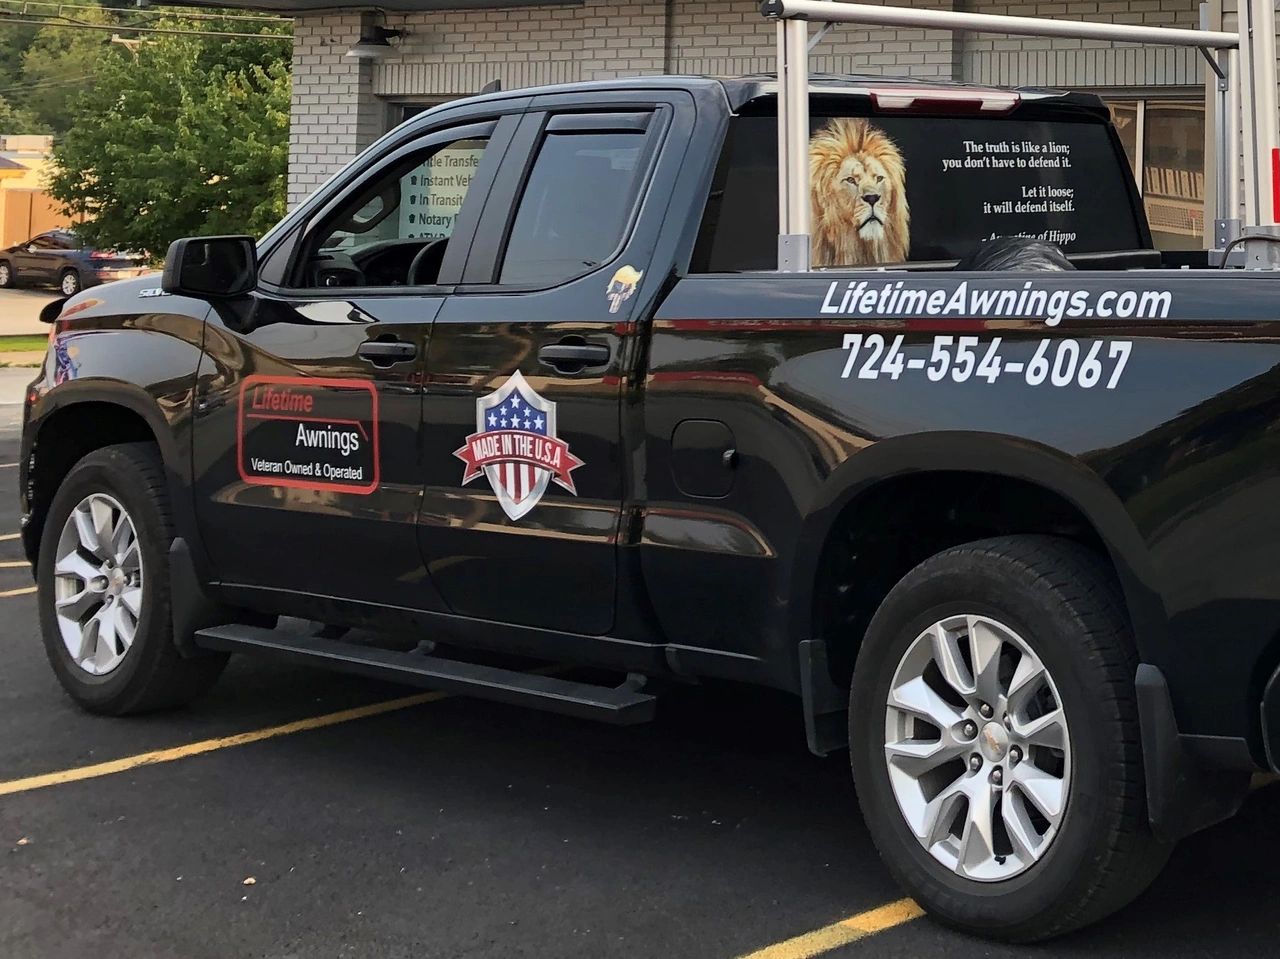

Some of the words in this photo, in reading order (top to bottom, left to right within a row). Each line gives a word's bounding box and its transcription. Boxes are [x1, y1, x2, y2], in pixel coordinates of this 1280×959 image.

[963, 141, 984, 153] The
[985, 141, 1010, 153] truth
[1011, 141, 1020, 153] is
[1022, 141, 1040, 153] like
[1041, 144, 1048, 153] a
[1049, 141, 1070, 155] lion;
[444, 155, 479, 167] Transfe
[942, 159, 962, 172] you
[964, 156, 990, 168] don't
[992, 156, 1015, 168] have
[1016, 157, 1027, 168] to
[1028, 156, 1060, 168] defend
[1062, 156, 1072, 168] it.
[420, 175, 453, 186] Instant
[419, 194, 429, 205] In
[431, 194, 463, 205] Transit
[1021, 186, 1037, 198] Let
[1039, 185, 1047, 198] it
[1048, 185, 1074, 198] loose;
[983, 201, 992, 214] it
[993, 201, 1013, 214] will
[1015, 201, 1048, 214] defend
[1049, 200, 1075, 212] itself.
[418, 213, 452, 229] Notary
[1037, 230, 1048, 241] of
[1048, 230, 1077, 245] Hippo
[820, 280, 1173, 326] LifetimeAwnings.com
[840, 333, 1134, 389] 724-554-6067
[252, 386, 313, 412] Lifetime
[295, 423, 360, 456] Awnings
[472, 435, 501, 462] MADE
[501, 434, 513, 455] IN
[513, 435, 533, 457] THE
[251, 457, 283, 473] Veteran
[284, 460, 313, 476] Owned
[314, 462, 322, 477] &
[323, 463, 363, 480] Operated
